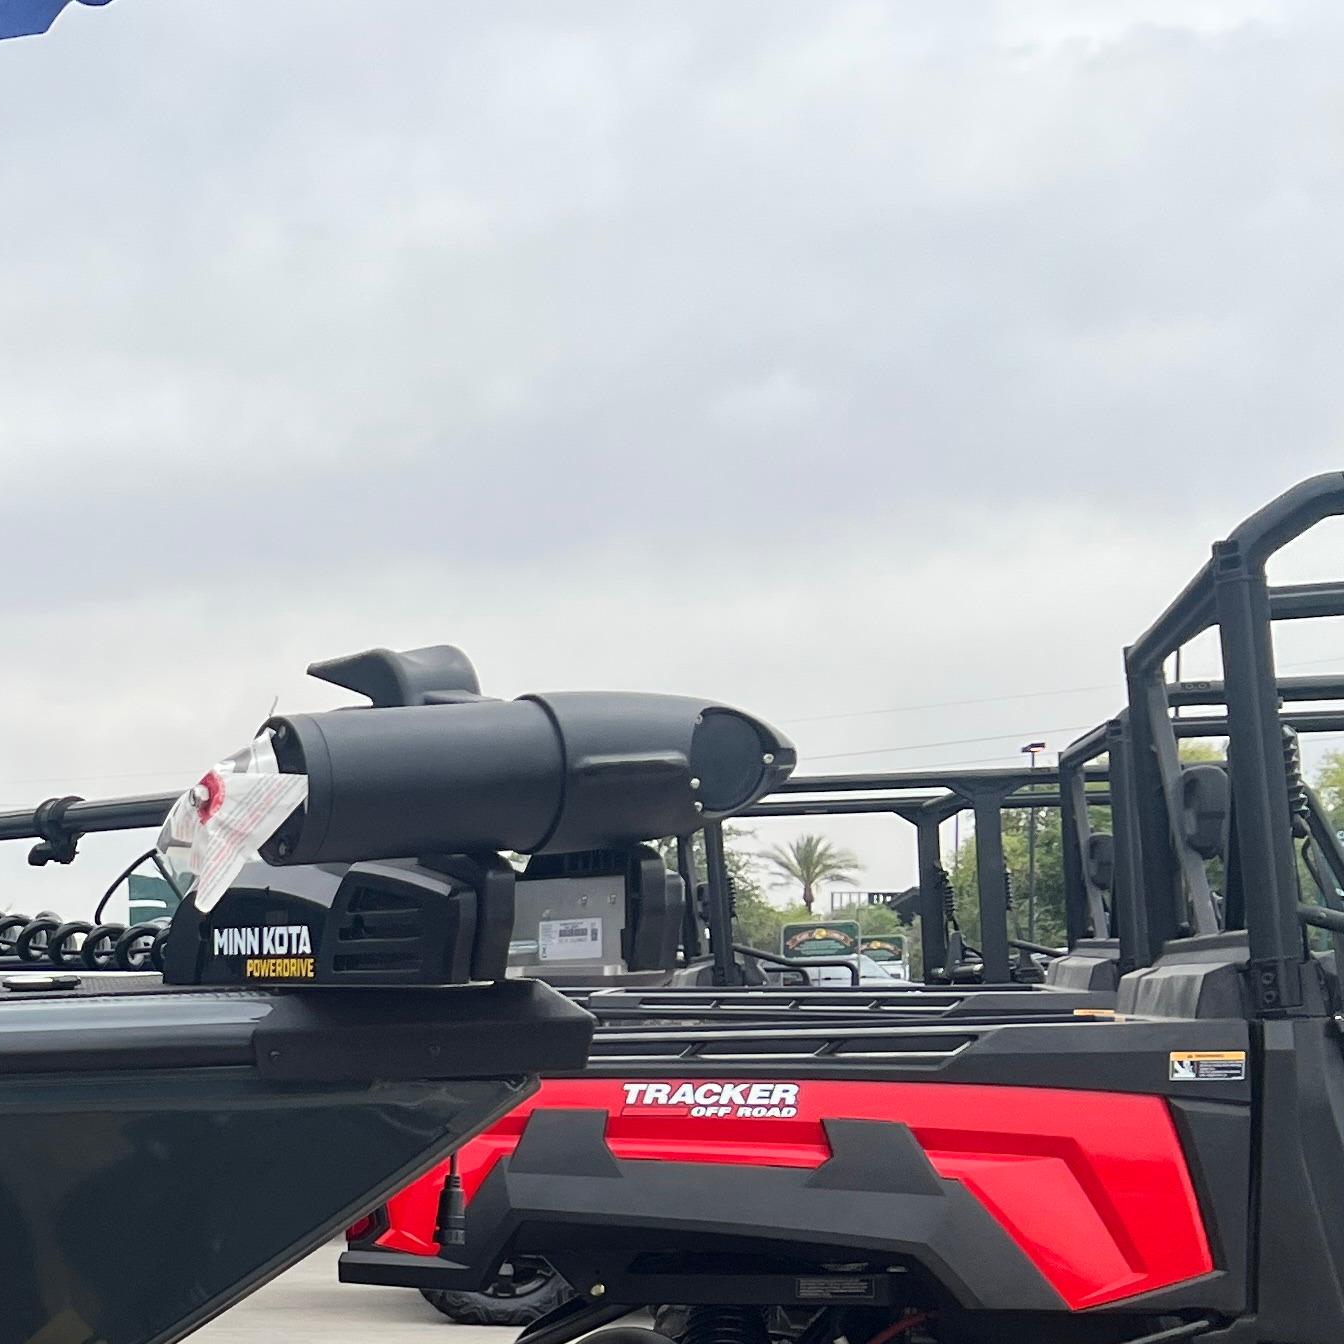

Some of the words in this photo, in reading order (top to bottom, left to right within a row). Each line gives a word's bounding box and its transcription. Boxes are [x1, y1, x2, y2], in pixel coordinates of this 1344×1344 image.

[214, 927, 260, 956] MINN
[262, 925, 312, 955] KOTA
[246, 958, 315, 978] POWERDRIVE
[623, 1083, 800, 1105] TRACKER
[690, 1106, 732, 1118] OFF
[736, 1106, 798, 1118] ROAD
